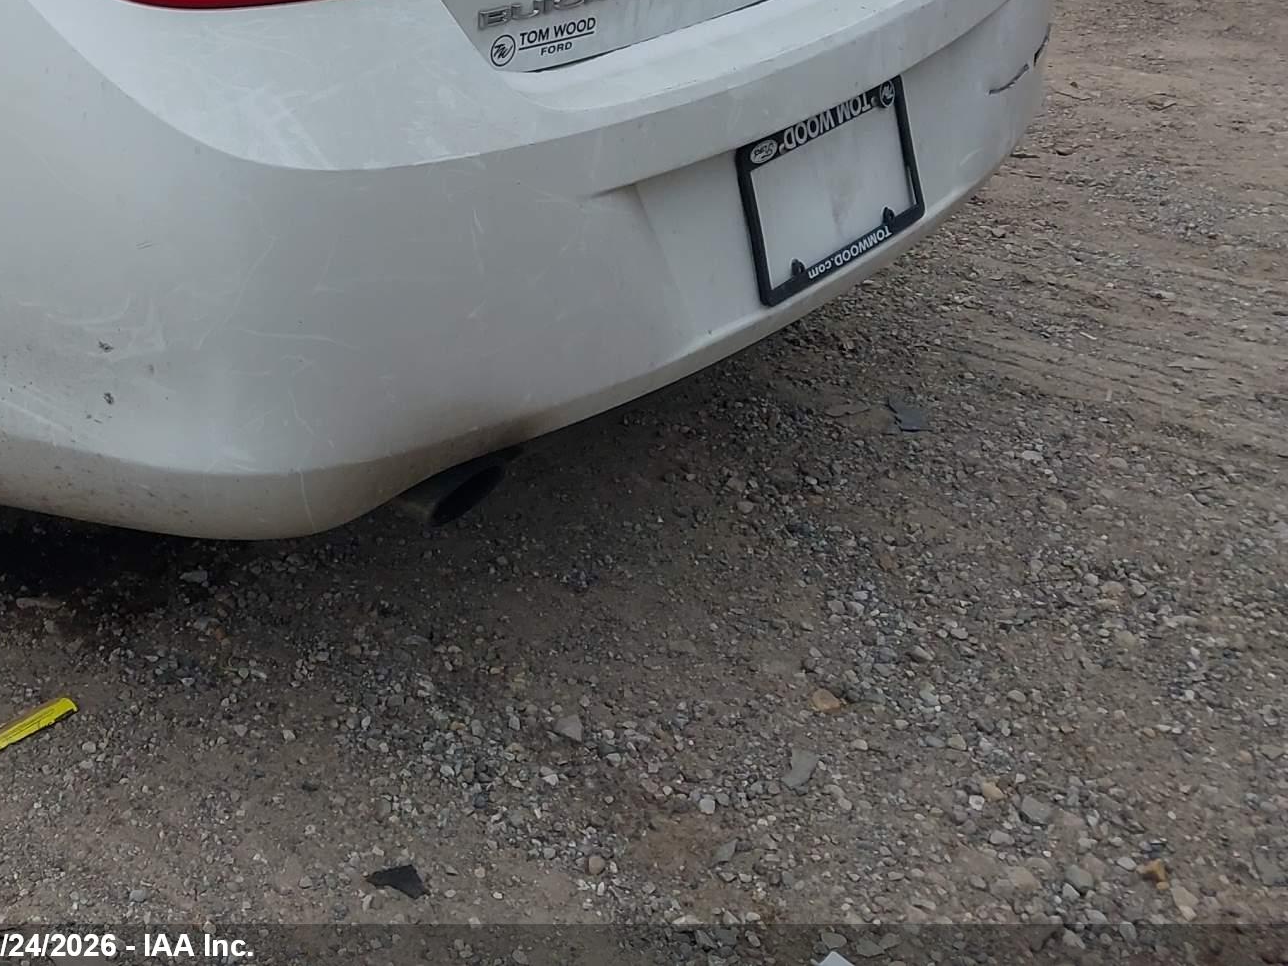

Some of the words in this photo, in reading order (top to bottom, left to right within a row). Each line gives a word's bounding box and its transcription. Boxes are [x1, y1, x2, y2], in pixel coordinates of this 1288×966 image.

[519, 27, 550, 45] TOM
[553, 17, 596, 38] WOOD
[540, 41, 573, 56] FORD
[837, 91, 871, 121] TOM
[783, 108, 835, 151] WOOD
[808, 224, 892, 279] TOMWOOD.com
